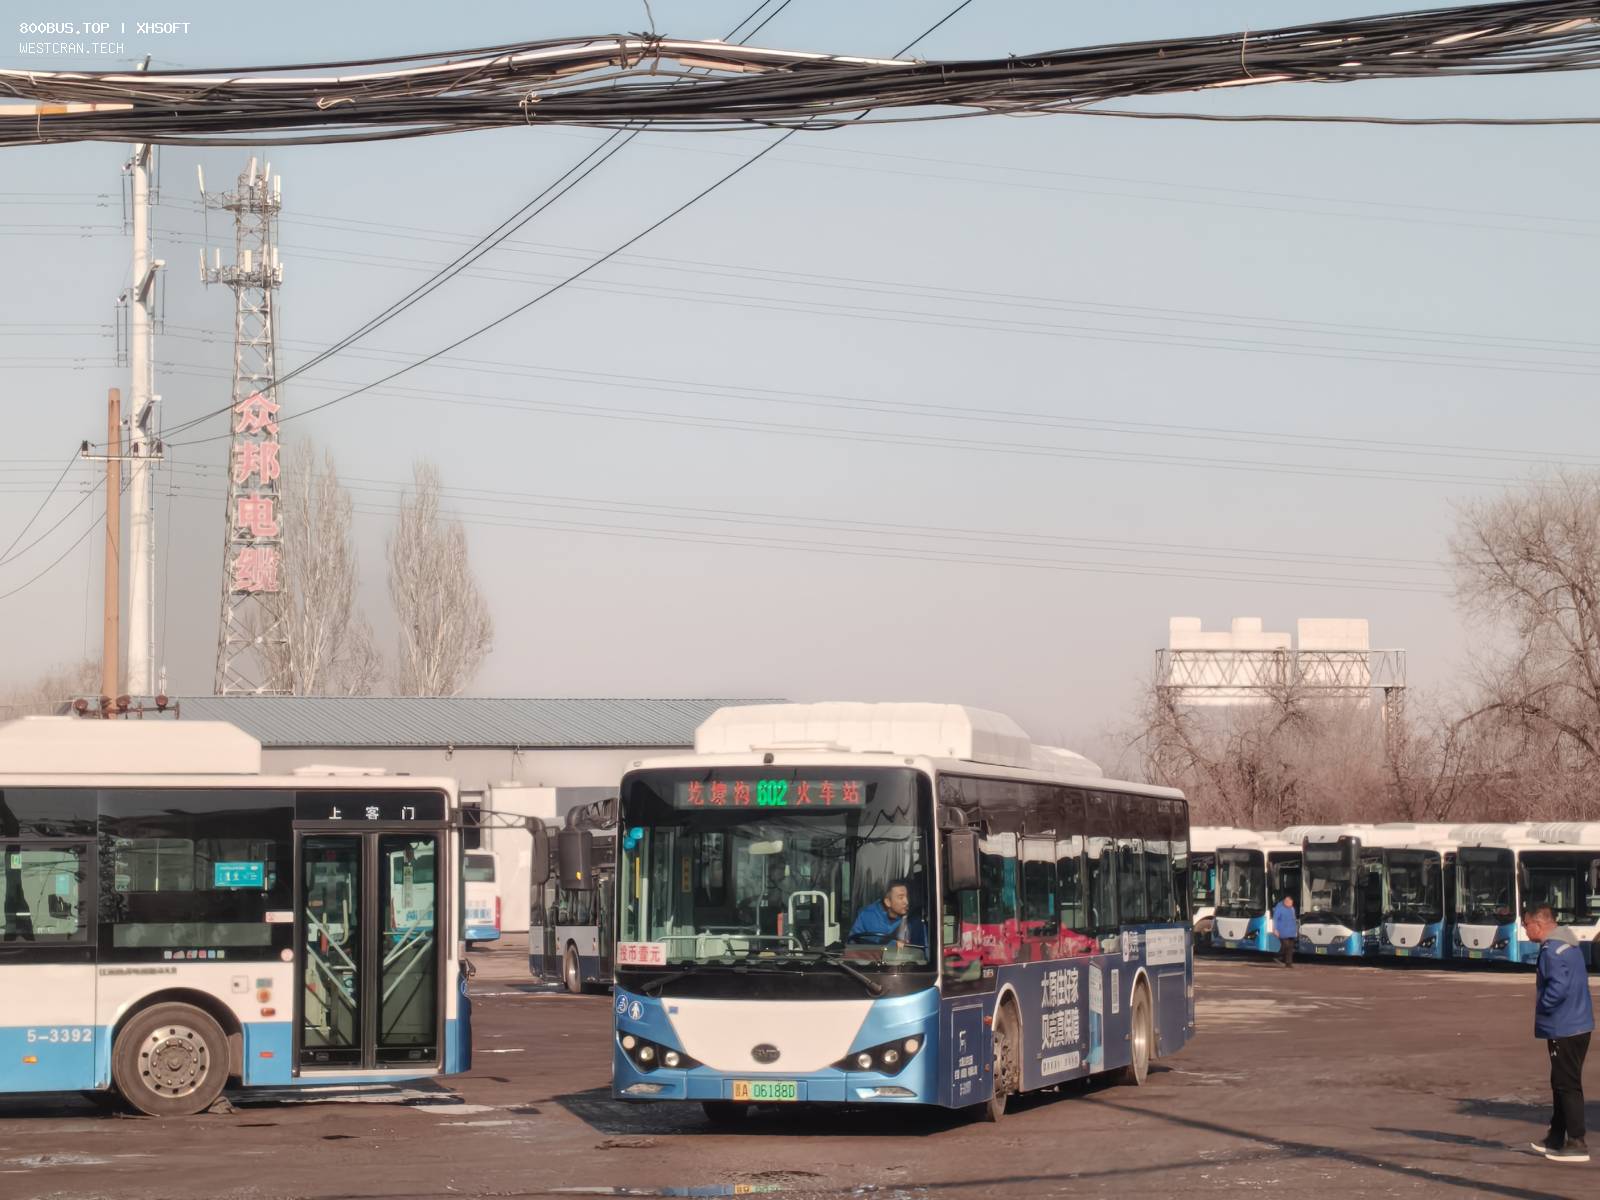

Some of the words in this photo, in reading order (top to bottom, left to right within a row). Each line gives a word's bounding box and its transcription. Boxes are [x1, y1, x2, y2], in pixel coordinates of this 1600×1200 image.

[234, 390, 281, 592] 众邦电缆
[756, 779, 788, 806] 602
[796, 780, 859, 806] 火车站
[328, 805, 416, 821] 上客门
[620, 944, 661, 962] 投币壹元
[27, 1028, 92, 1043] 5-3392
[1041, 1006, 1080, 1051] 贝壳真保障
